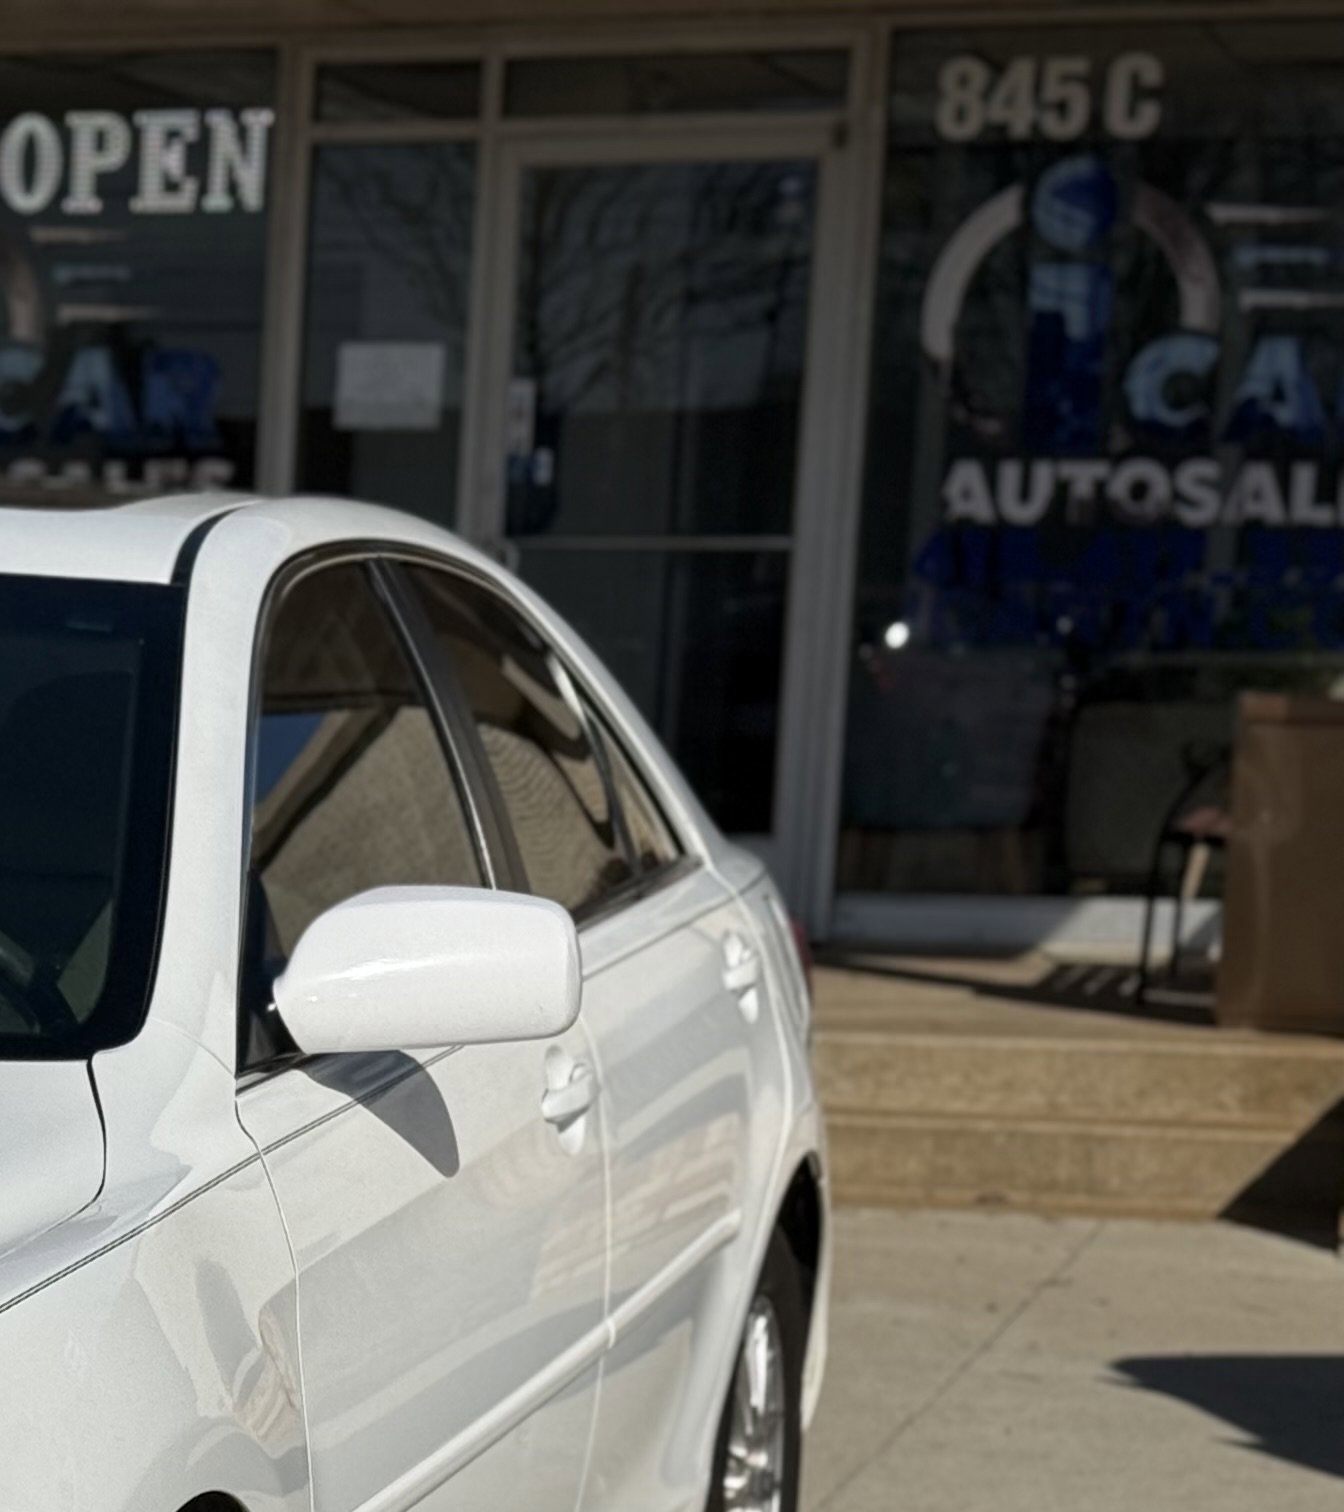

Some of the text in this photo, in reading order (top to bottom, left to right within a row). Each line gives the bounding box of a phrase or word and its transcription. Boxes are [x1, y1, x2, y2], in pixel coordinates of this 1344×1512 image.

[934, 52, 1165, 143] 845 C
[941, 456, 1344, 527] AUTOSAL
